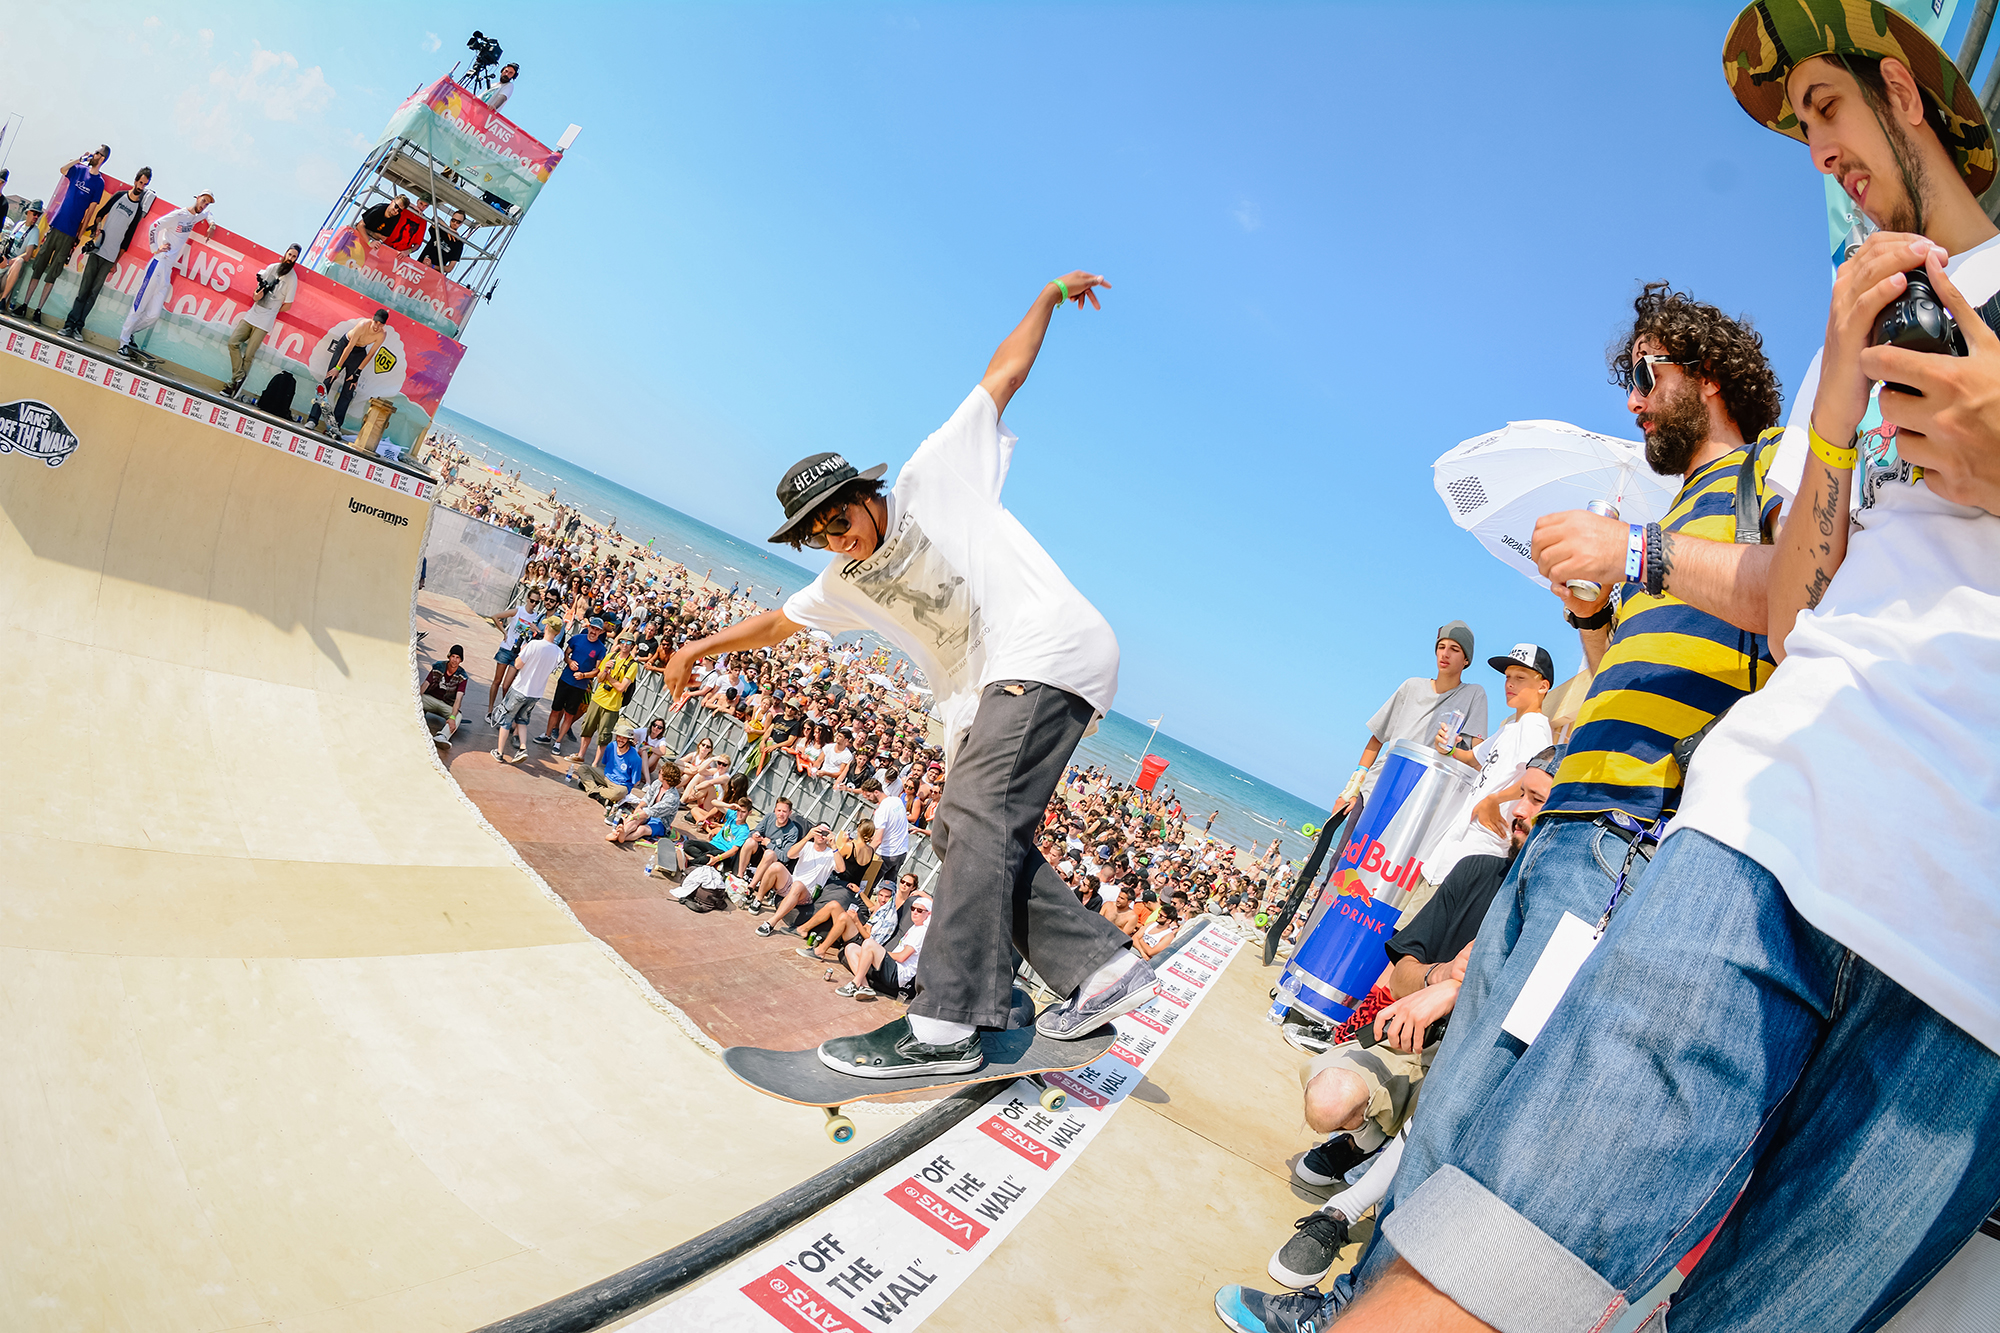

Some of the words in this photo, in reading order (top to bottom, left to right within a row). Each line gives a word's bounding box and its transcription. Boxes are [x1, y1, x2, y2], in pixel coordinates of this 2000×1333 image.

[377, 354, 392, 370] 105
[20, 403, 52, 429] VANS
[17, 423, 41, 451] THE
[348, 497, 408, 526] Ignoramps
[1812, 468, 1840, 537] Finest
[1341, 833, 1369, 865] ed
[1359, 839, 1424, 892] Bull
[1340, 903, 1386, 934] DRINK
[1112, 1044, 1138, 1064] VAN
[1078, 1066, 1101, 1085] THE
[1098, 1068, 1128, 1096] WALL"
[997, 1097, 1029, 1121] "OFF
[1023, 1105, 1054, 1135] THE
[1048, 1114, 1086, 1149] WALL"
[913, 1154, 956, 1185] "OFF
[946, 1173, 986, 1203] THE
[975, 1174, 1027, 1222] WALL"
[786, 1232, 846, 1275] "OFF
[826, 1256, 884, 1299] THE
[861, 1258, 938, 1325] WALL"
